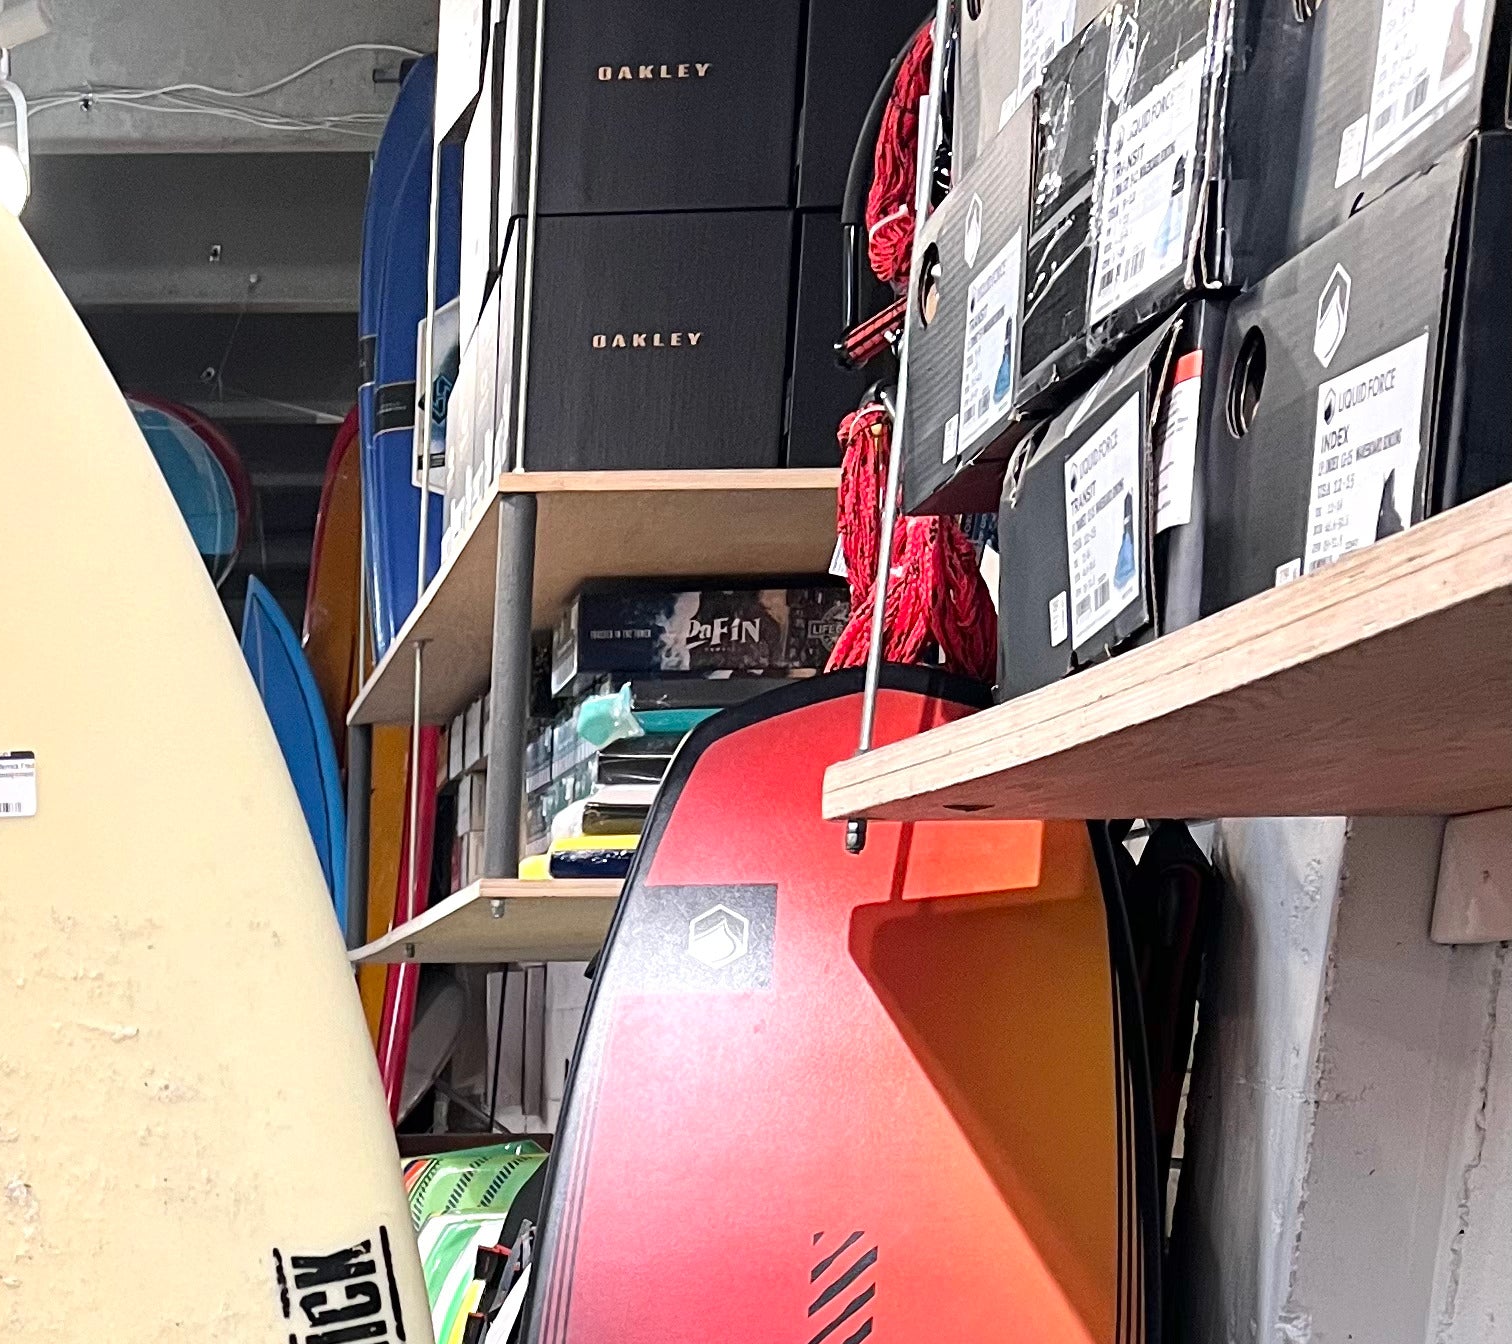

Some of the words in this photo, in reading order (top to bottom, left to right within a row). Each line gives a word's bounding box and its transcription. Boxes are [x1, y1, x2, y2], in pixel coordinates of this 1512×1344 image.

[597, 62, 712, 81] OAKLEY
[591, 332, 703, 348] OAKLEY
[1320, 424, 1350, 454] INDEX
